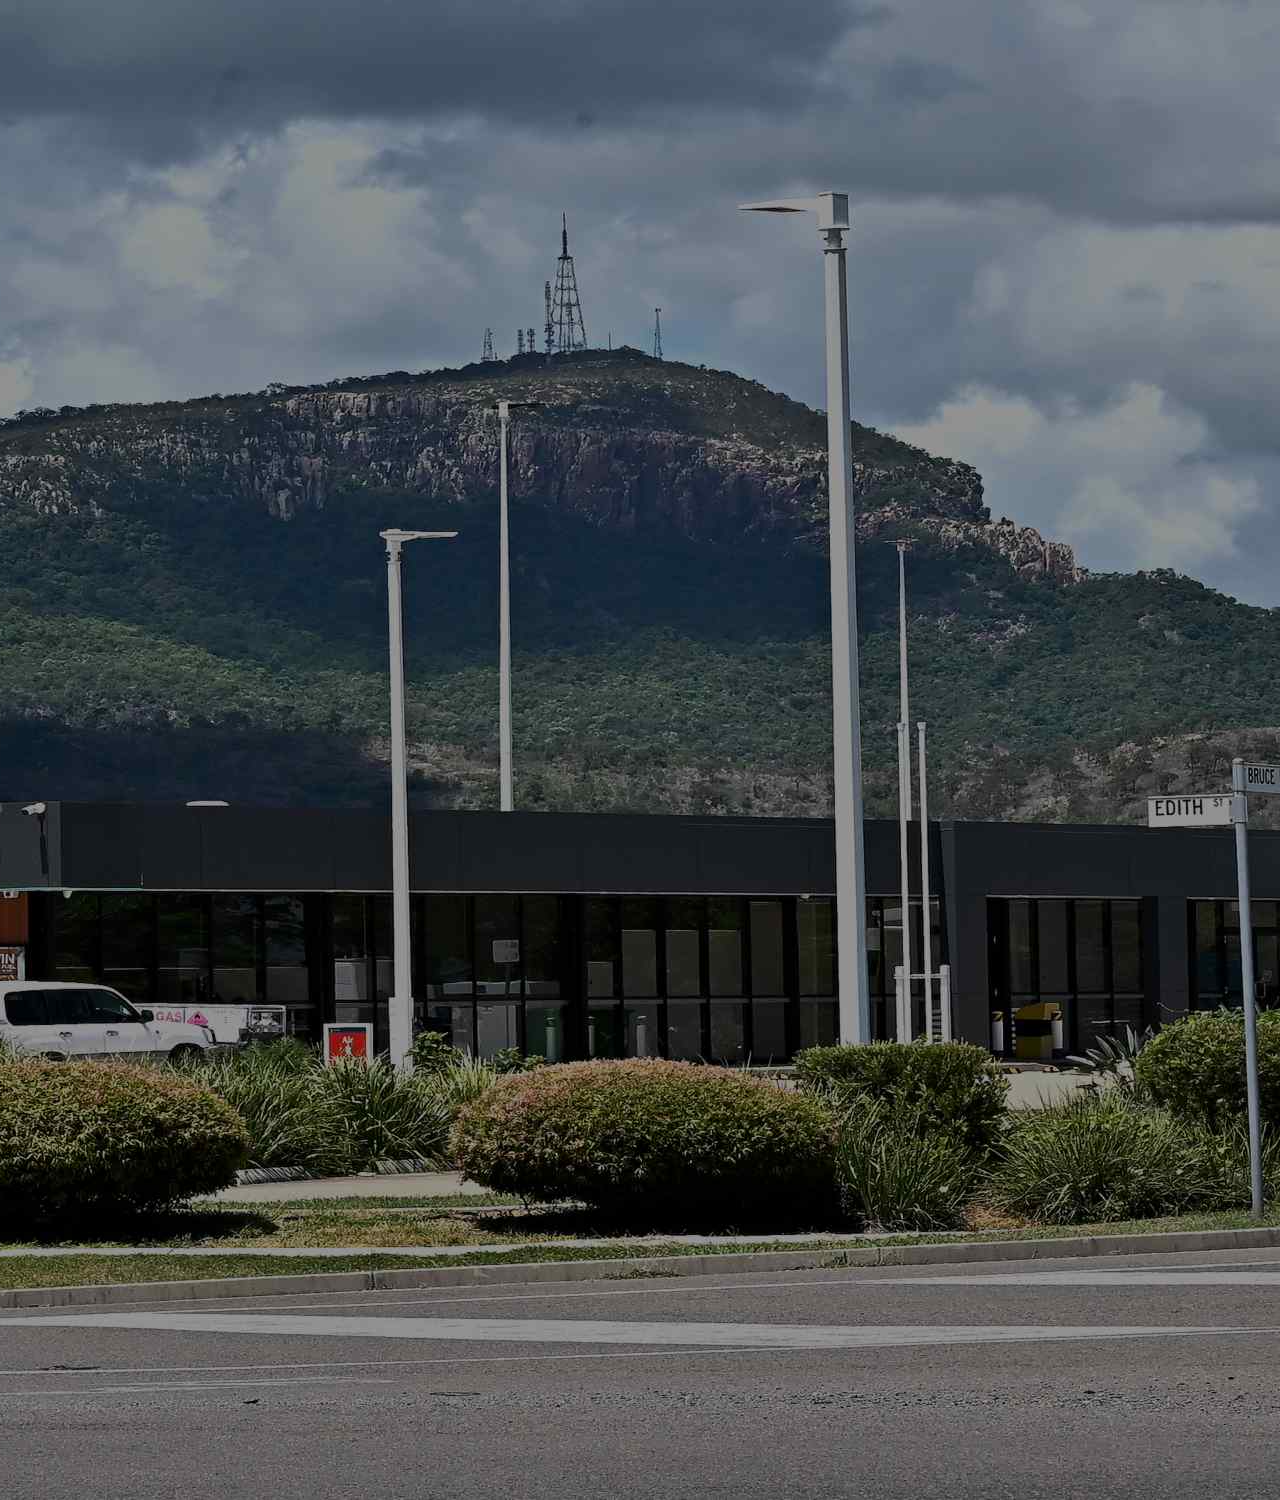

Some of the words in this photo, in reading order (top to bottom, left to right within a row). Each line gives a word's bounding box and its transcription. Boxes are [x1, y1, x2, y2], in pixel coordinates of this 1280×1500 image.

[1248, 767, 1276, 785] BRUCE
[1155, 799, 1203, 816] EDITH
[156, 1012, 183, 1023] GAS
